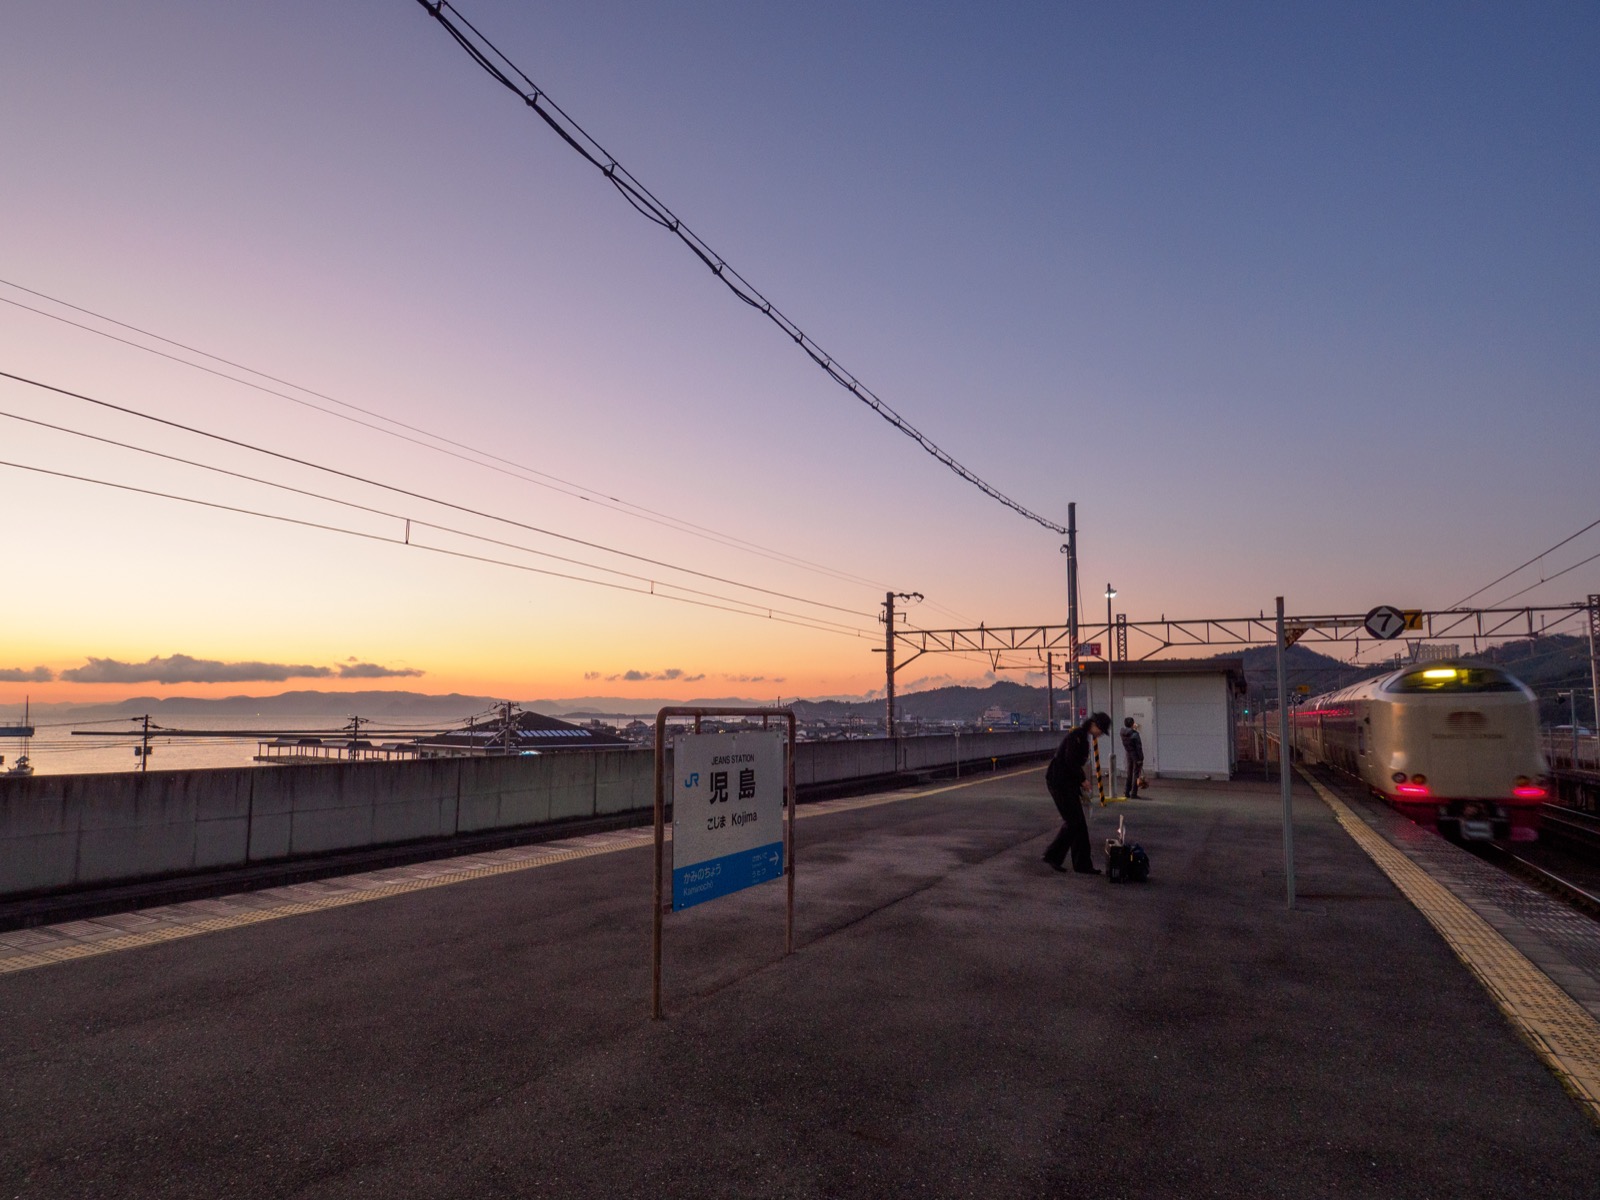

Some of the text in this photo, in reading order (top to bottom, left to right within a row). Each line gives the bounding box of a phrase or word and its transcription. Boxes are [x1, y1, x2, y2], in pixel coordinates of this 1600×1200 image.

[1376, 613, 1393, 632] 7
[1404, 612, 1420, 628] 7
[712, 753, 755, 766] JEANS STATION
[685, 773, 699, 788] JR
[710, 768, 756, 805] 児島
[707, 811, 758, 831] こじま Kojima
[684, 864, 722, 885] かみのちょう
